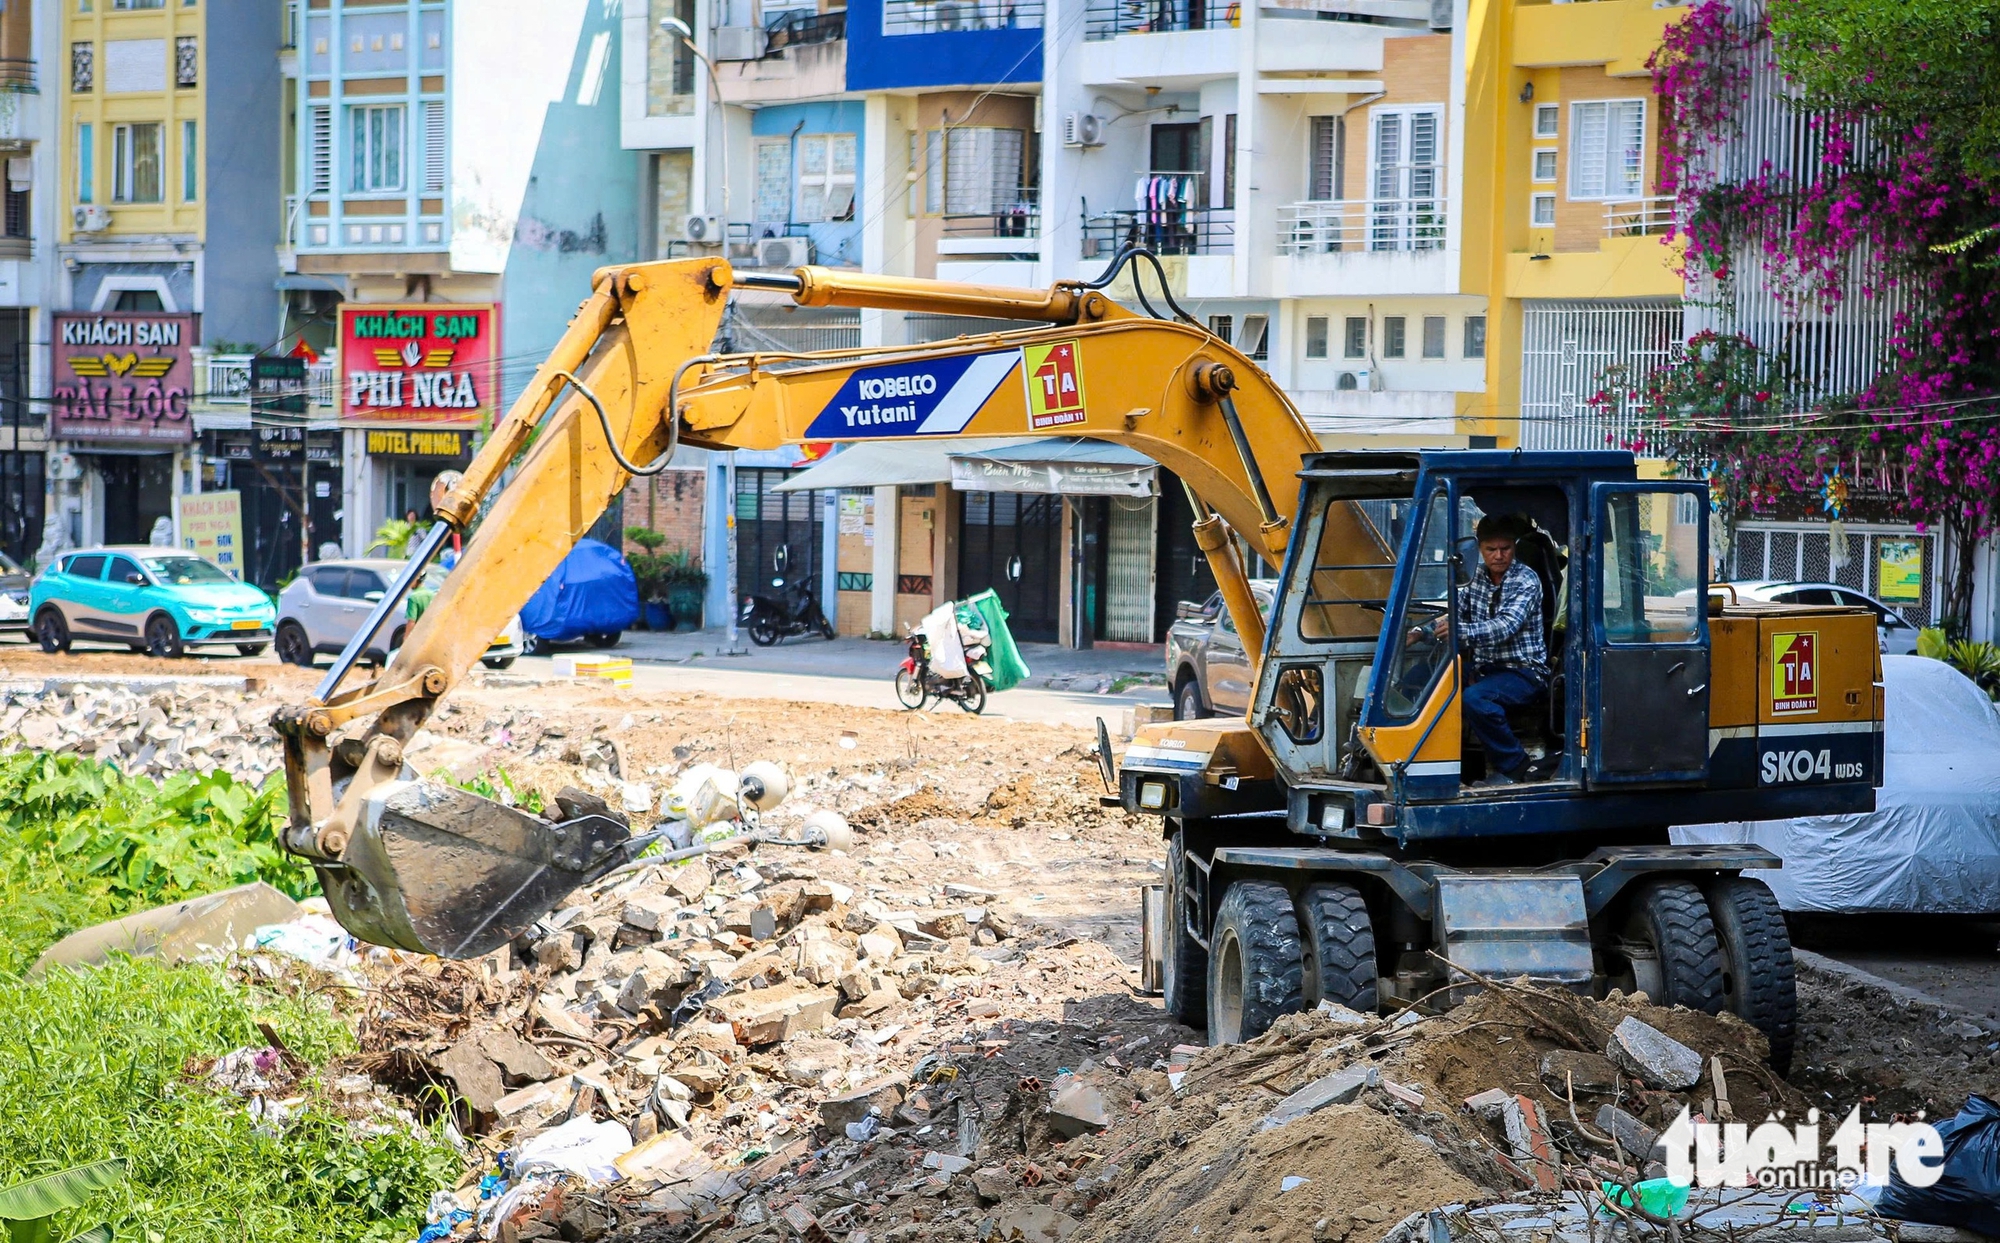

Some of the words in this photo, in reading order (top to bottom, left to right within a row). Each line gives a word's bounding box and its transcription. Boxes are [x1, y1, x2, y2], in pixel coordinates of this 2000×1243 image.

[62, 317, 132, 346] KHÁCH
[136, 321, 180, 354] SẠN
[355, 311, 426, 338] KHÁCH
[434, 315, 478, 343] SẠN
[349, 371, 404, 408] PHI
[411, 372, 480, 408] NGA
[859, 374, 937, 401] KOBELCO
[55, 376, 110, 421] TÀI
[123, 377, 189, 428] LỘC
[839, 401, 917, 427] Yutani
[1034, 416, 1053, 427] BINH
[1053, 413, 1074, 424] ĐOÀN
[1075, 412, 1084, 421] 11
[368, 430, 410, 454] HOTEL
[1774, 701, 1790, 711] BINH
[1791, 700, 1808, 710] ĐOÀN
[1808, 699, 1816, 708] 11
[1835, 762, 1863, 779] WDS
